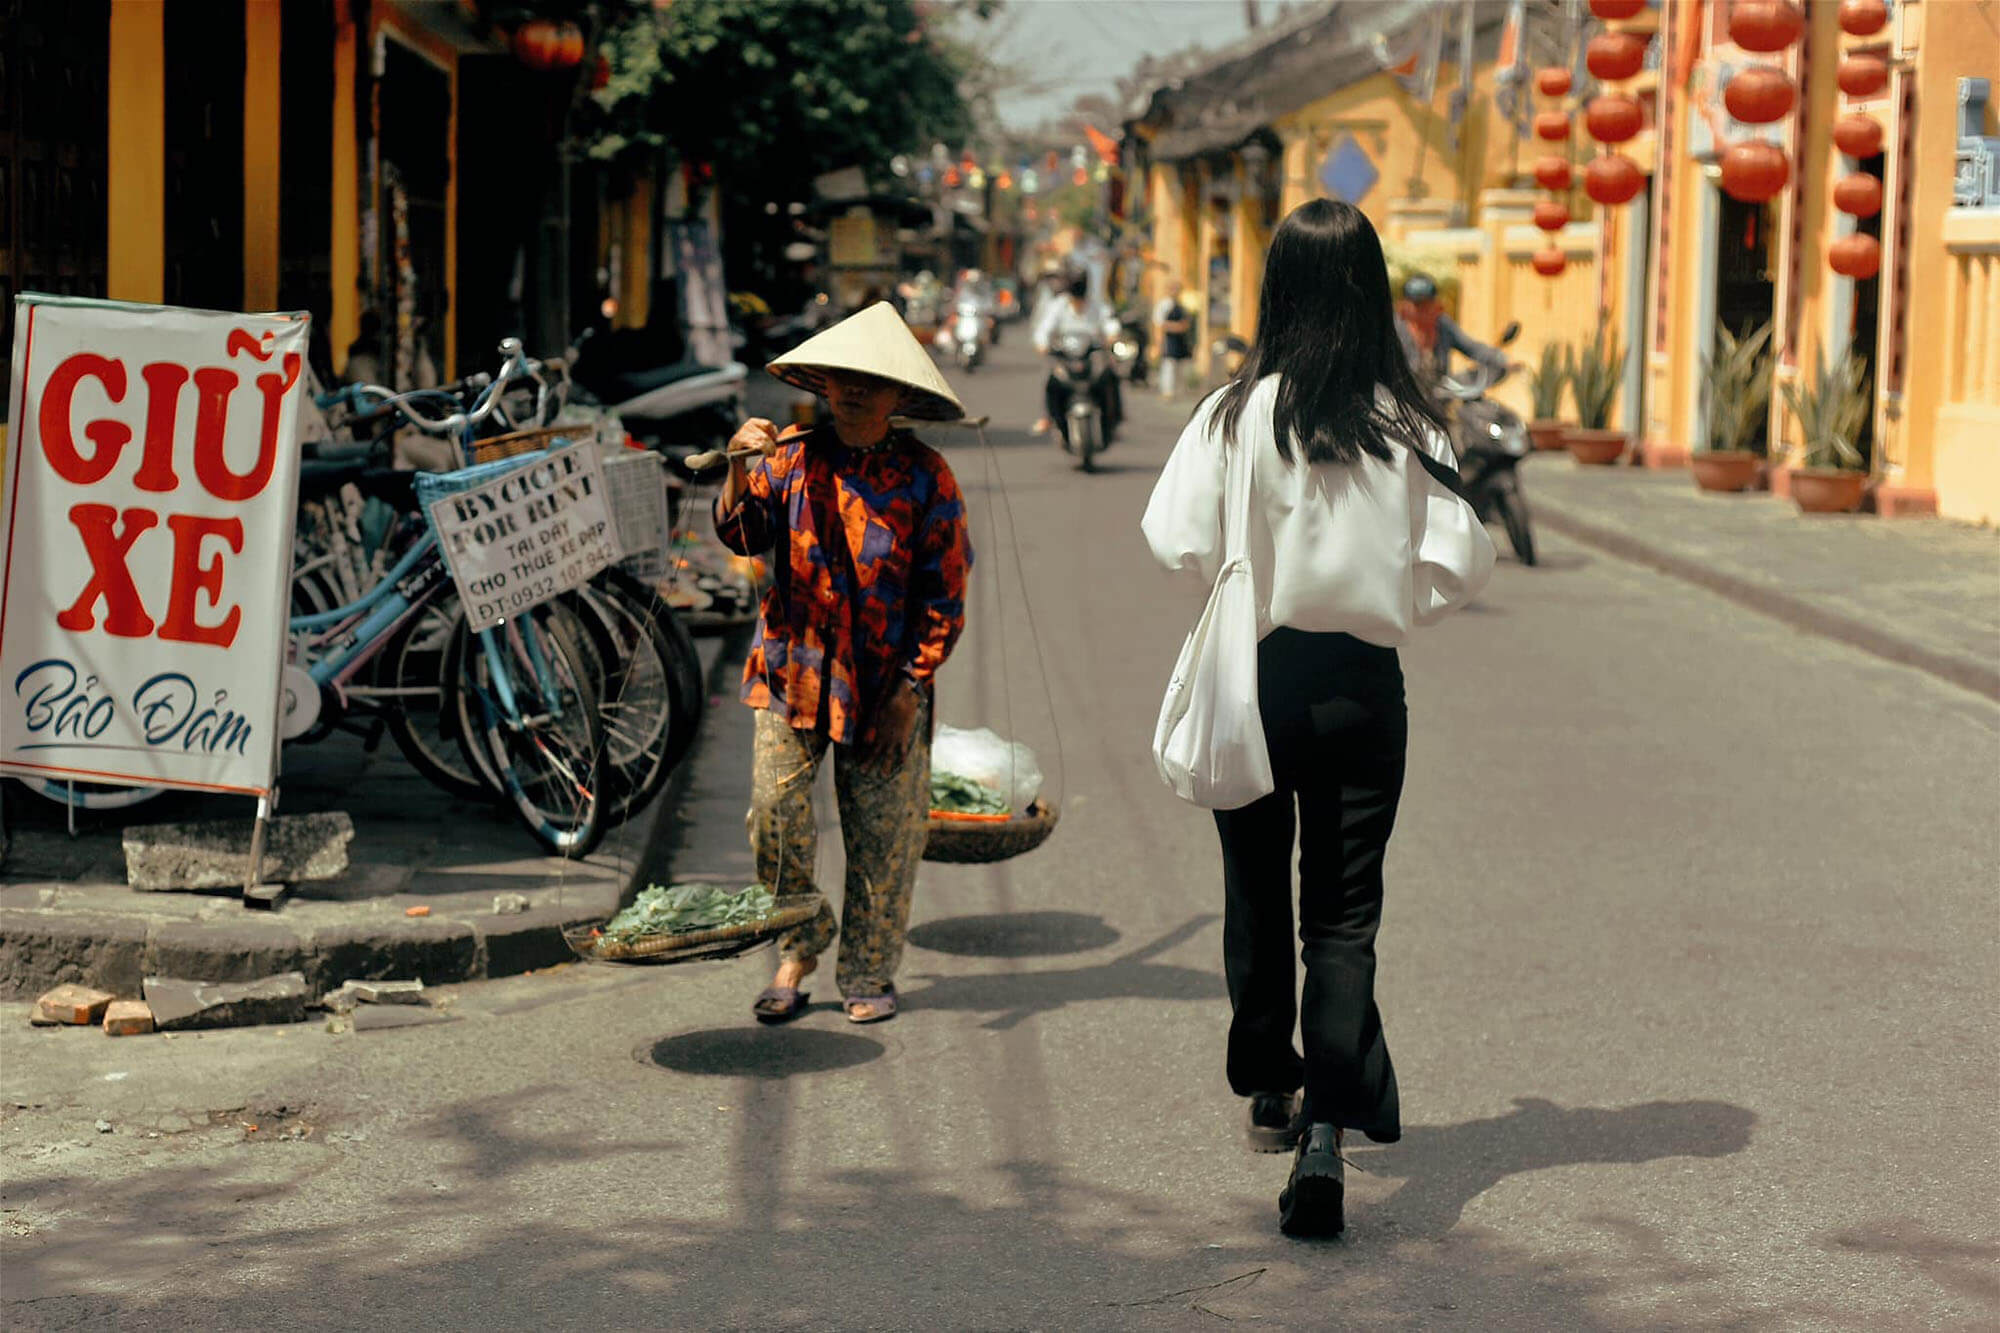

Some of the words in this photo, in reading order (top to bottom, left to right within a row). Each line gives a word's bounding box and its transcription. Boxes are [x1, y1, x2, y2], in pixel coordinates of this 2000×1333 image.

[38, 326, 302, 502] GIỮ
[451, 513, 520, 554] FOR
[525, 471, 595, 524] RENT
[57, 502, 244, 649] XE
[469, 572, 506, 595] CHO
[559, 537, 576, 559] XE
[15, 658, 118, 740] Bảo
[132, 672, 251, 757] Đảm
